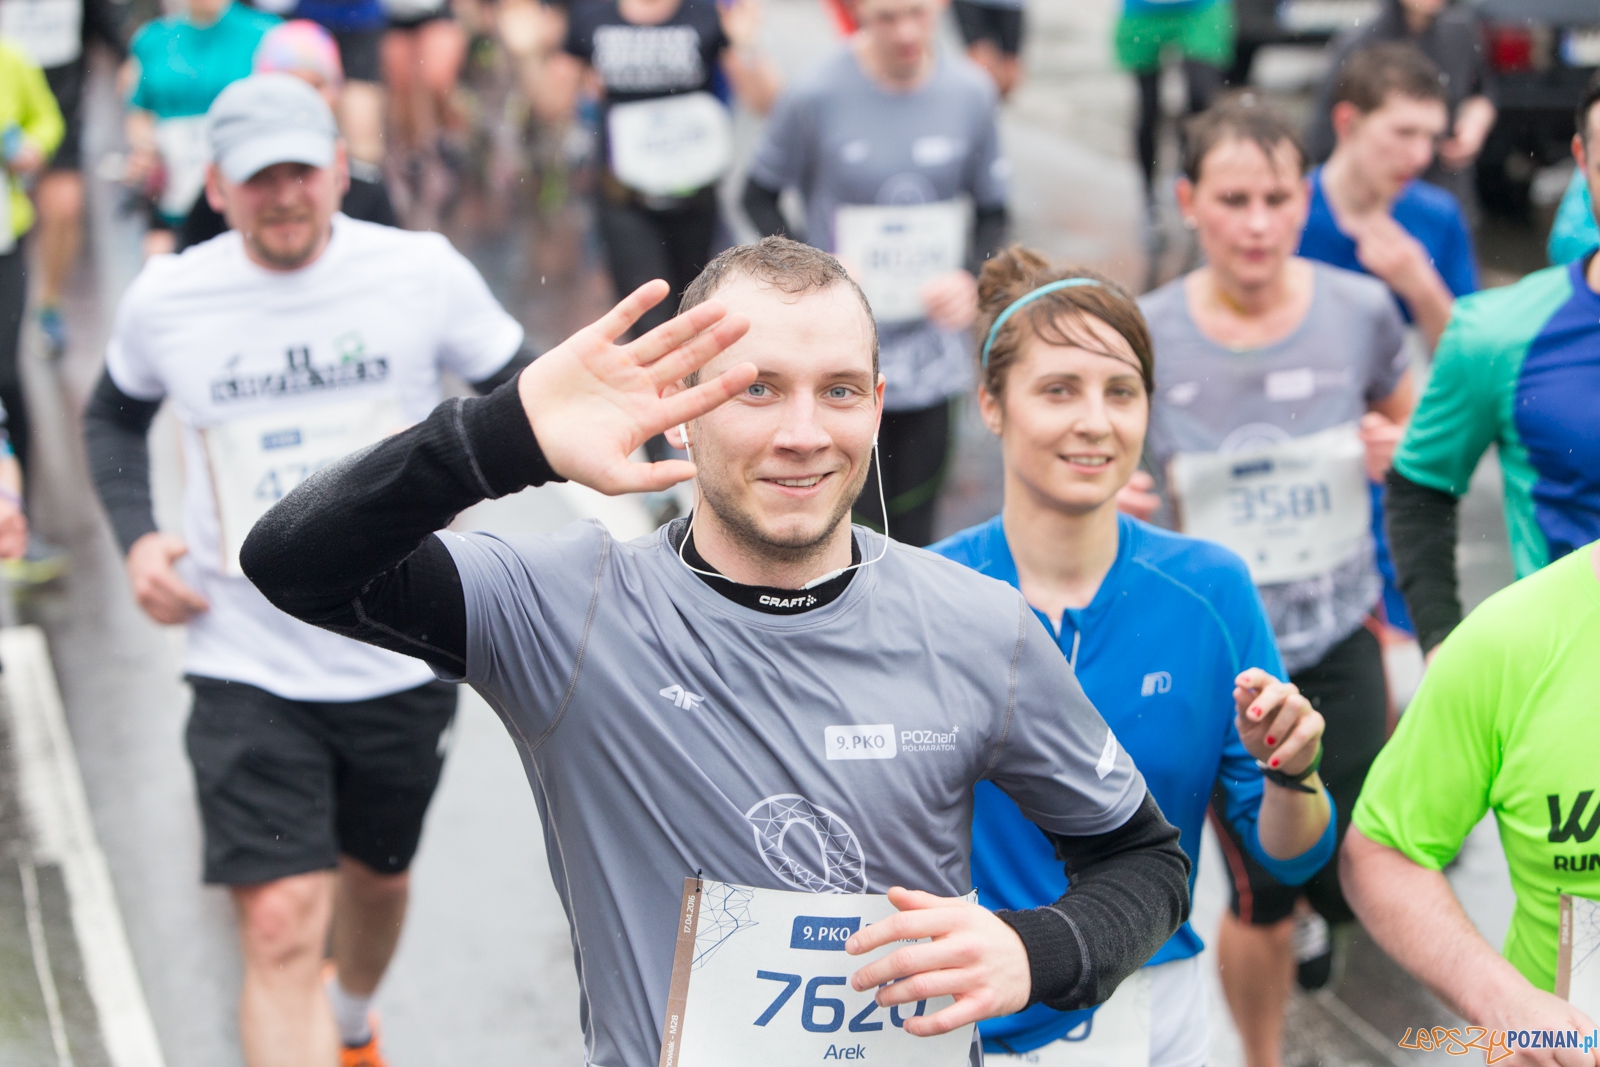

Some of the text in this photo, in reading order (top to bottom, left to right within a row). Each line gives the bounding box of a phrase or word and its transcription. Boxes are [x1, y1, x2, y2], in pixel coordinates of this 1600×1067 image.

[758, 594, 806, 608] CRAFT
[836, 734, 886, 750] 9. PKO
[902, 744, 956, 752] PÓŁMARATON
[683, 894, 696, 935] 17.04.2016
[802, 925, 851, 942] 9. PKO
[669, 1014, 679, 1034] M28
[823, 1043, 866, 1060] Arek
